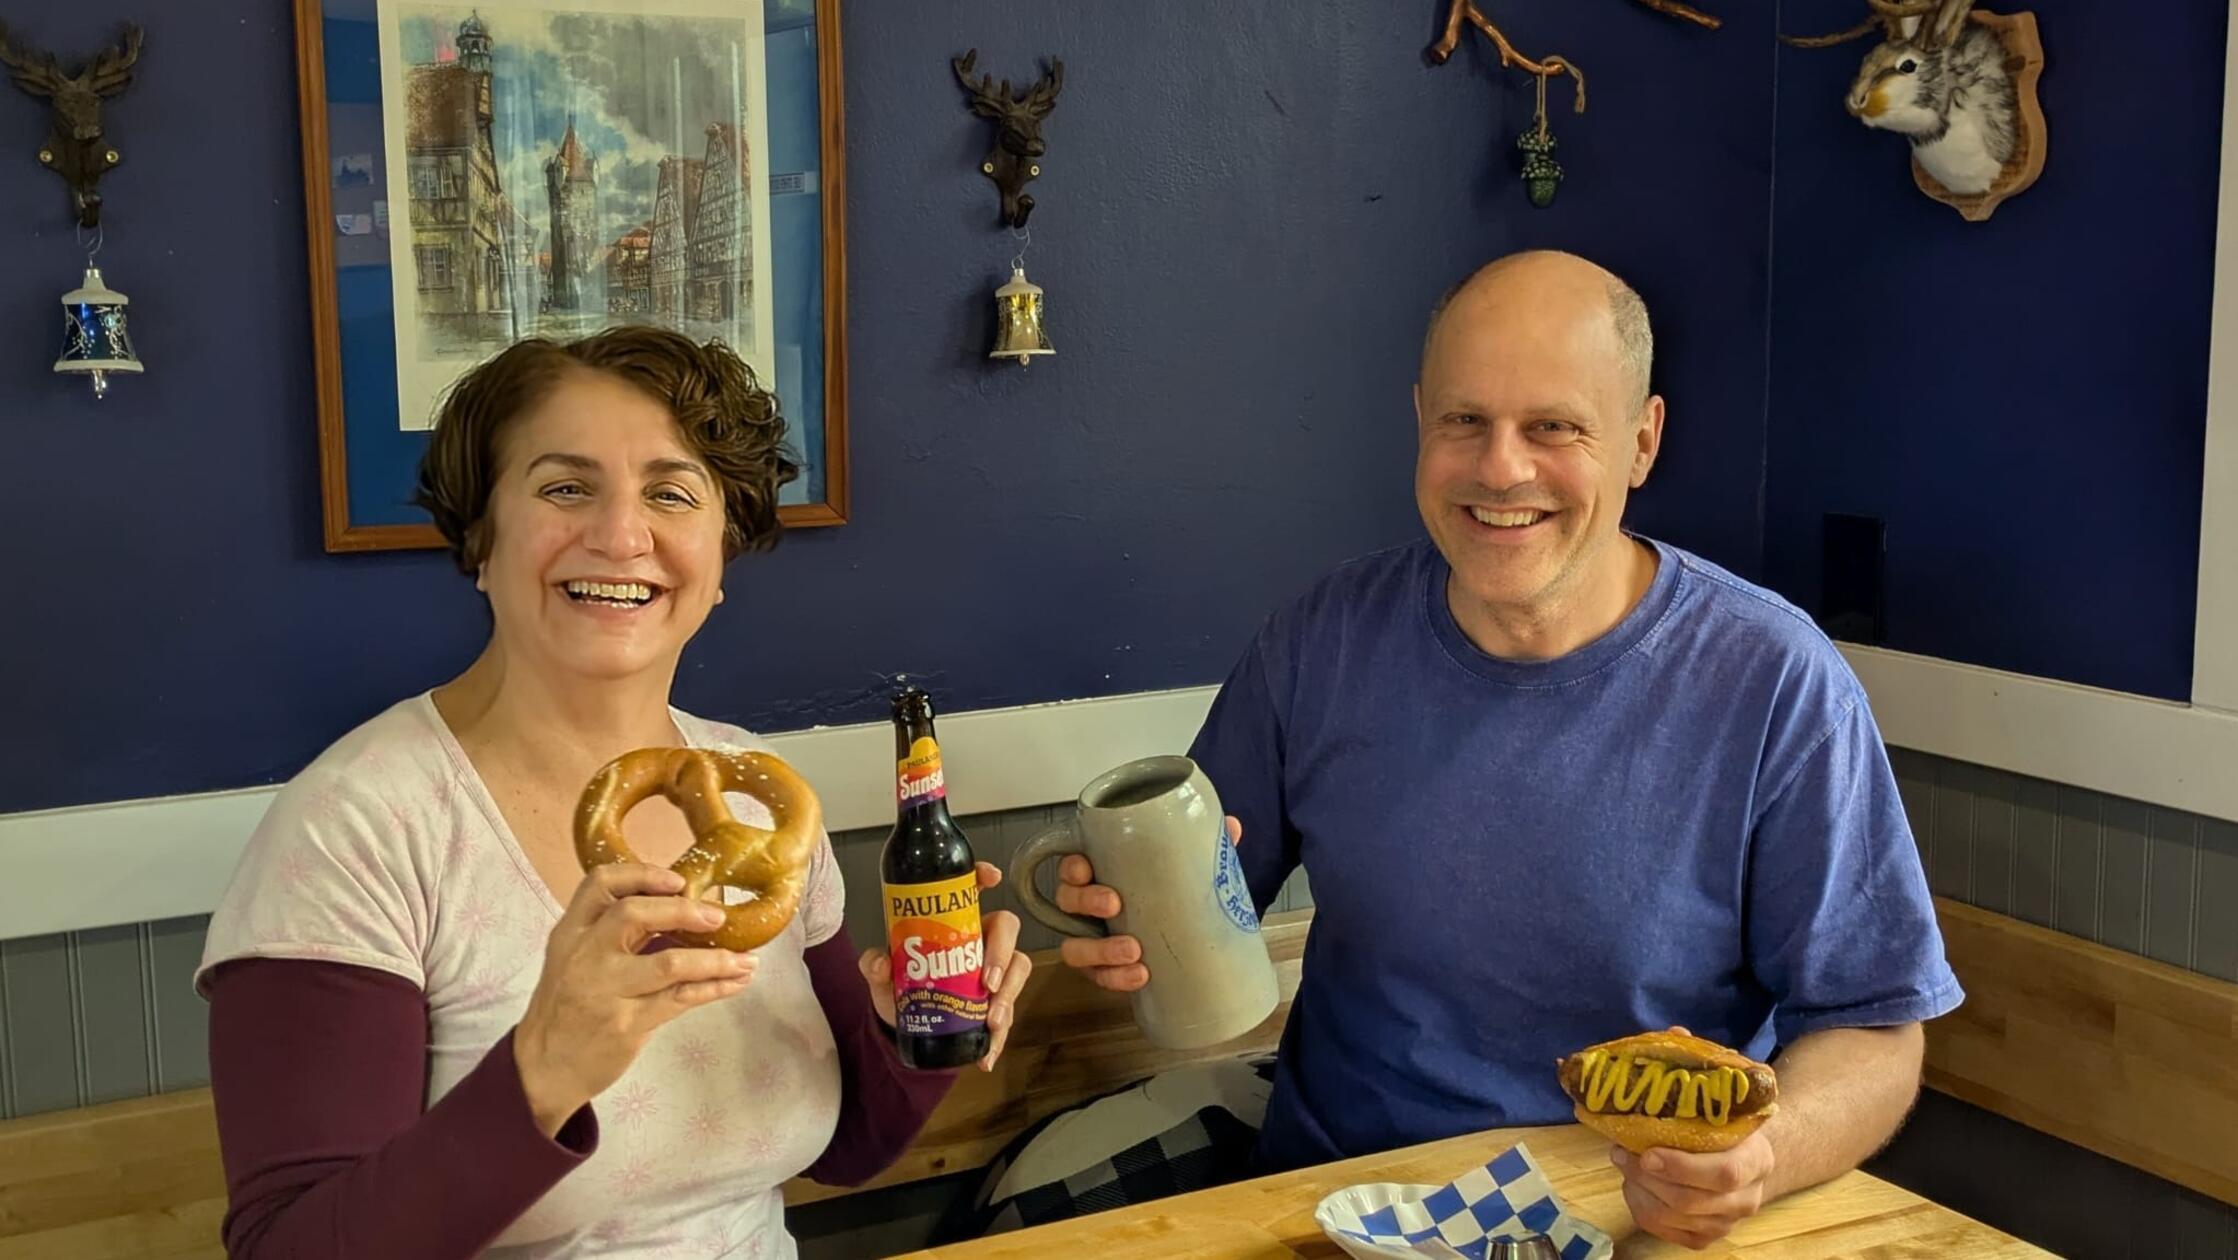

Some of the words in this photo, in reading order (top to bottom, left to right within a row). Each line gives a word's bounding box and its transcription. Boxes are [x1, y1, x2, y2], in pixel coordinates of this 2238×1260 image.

[1215, 831, 1229, 888] Brau
[910, 989, 931, 1001] with
[932, 992, 965, 1009] orange
